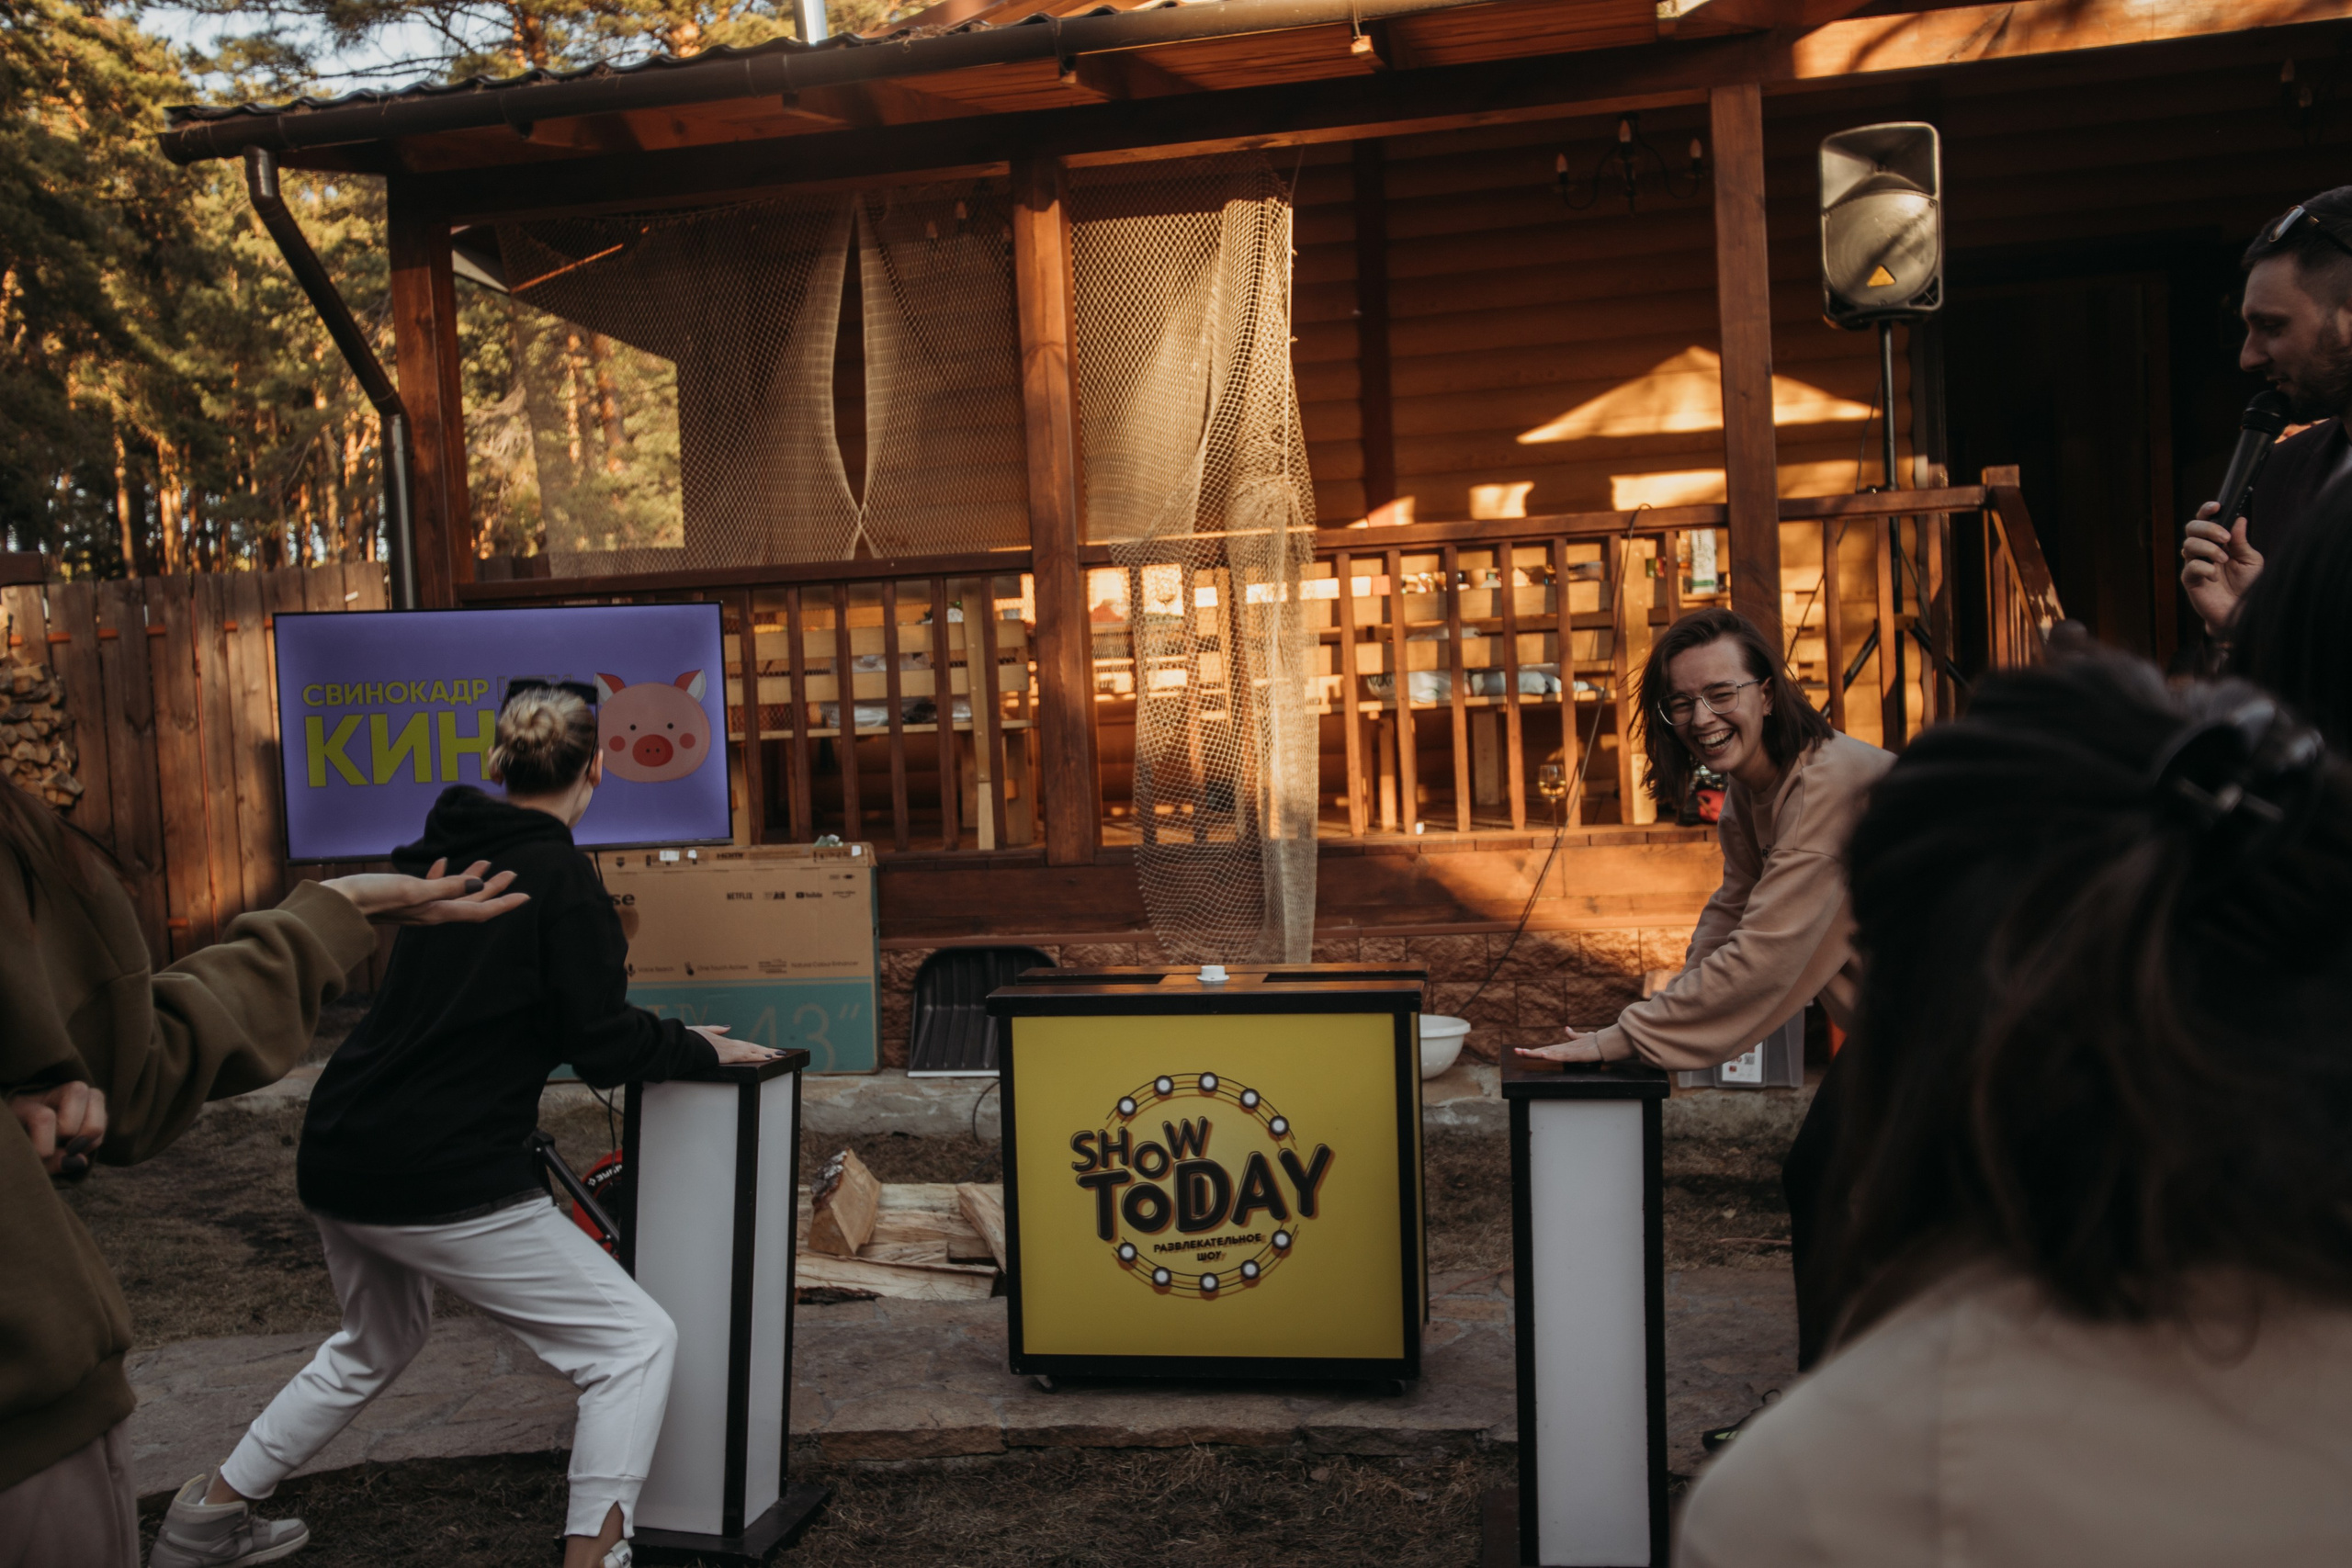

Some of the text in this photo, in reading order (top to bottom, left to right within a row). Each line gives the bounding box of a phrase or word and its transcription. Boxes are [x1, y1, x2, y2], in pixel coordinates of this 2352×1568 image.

[301, 677, 490, 707] СВИНОКАДР
[303, 709, 497, 788] КИН
[727, 892, 752, 900] NETFLIX
[1069, 1116, 1213, 1179] SHOW
[1153, 1233, 1263, 1254] РАЗВЛЕКАТЕЛЬНОЕ
[1196, 1250, 1223, 1262] ШОУ
